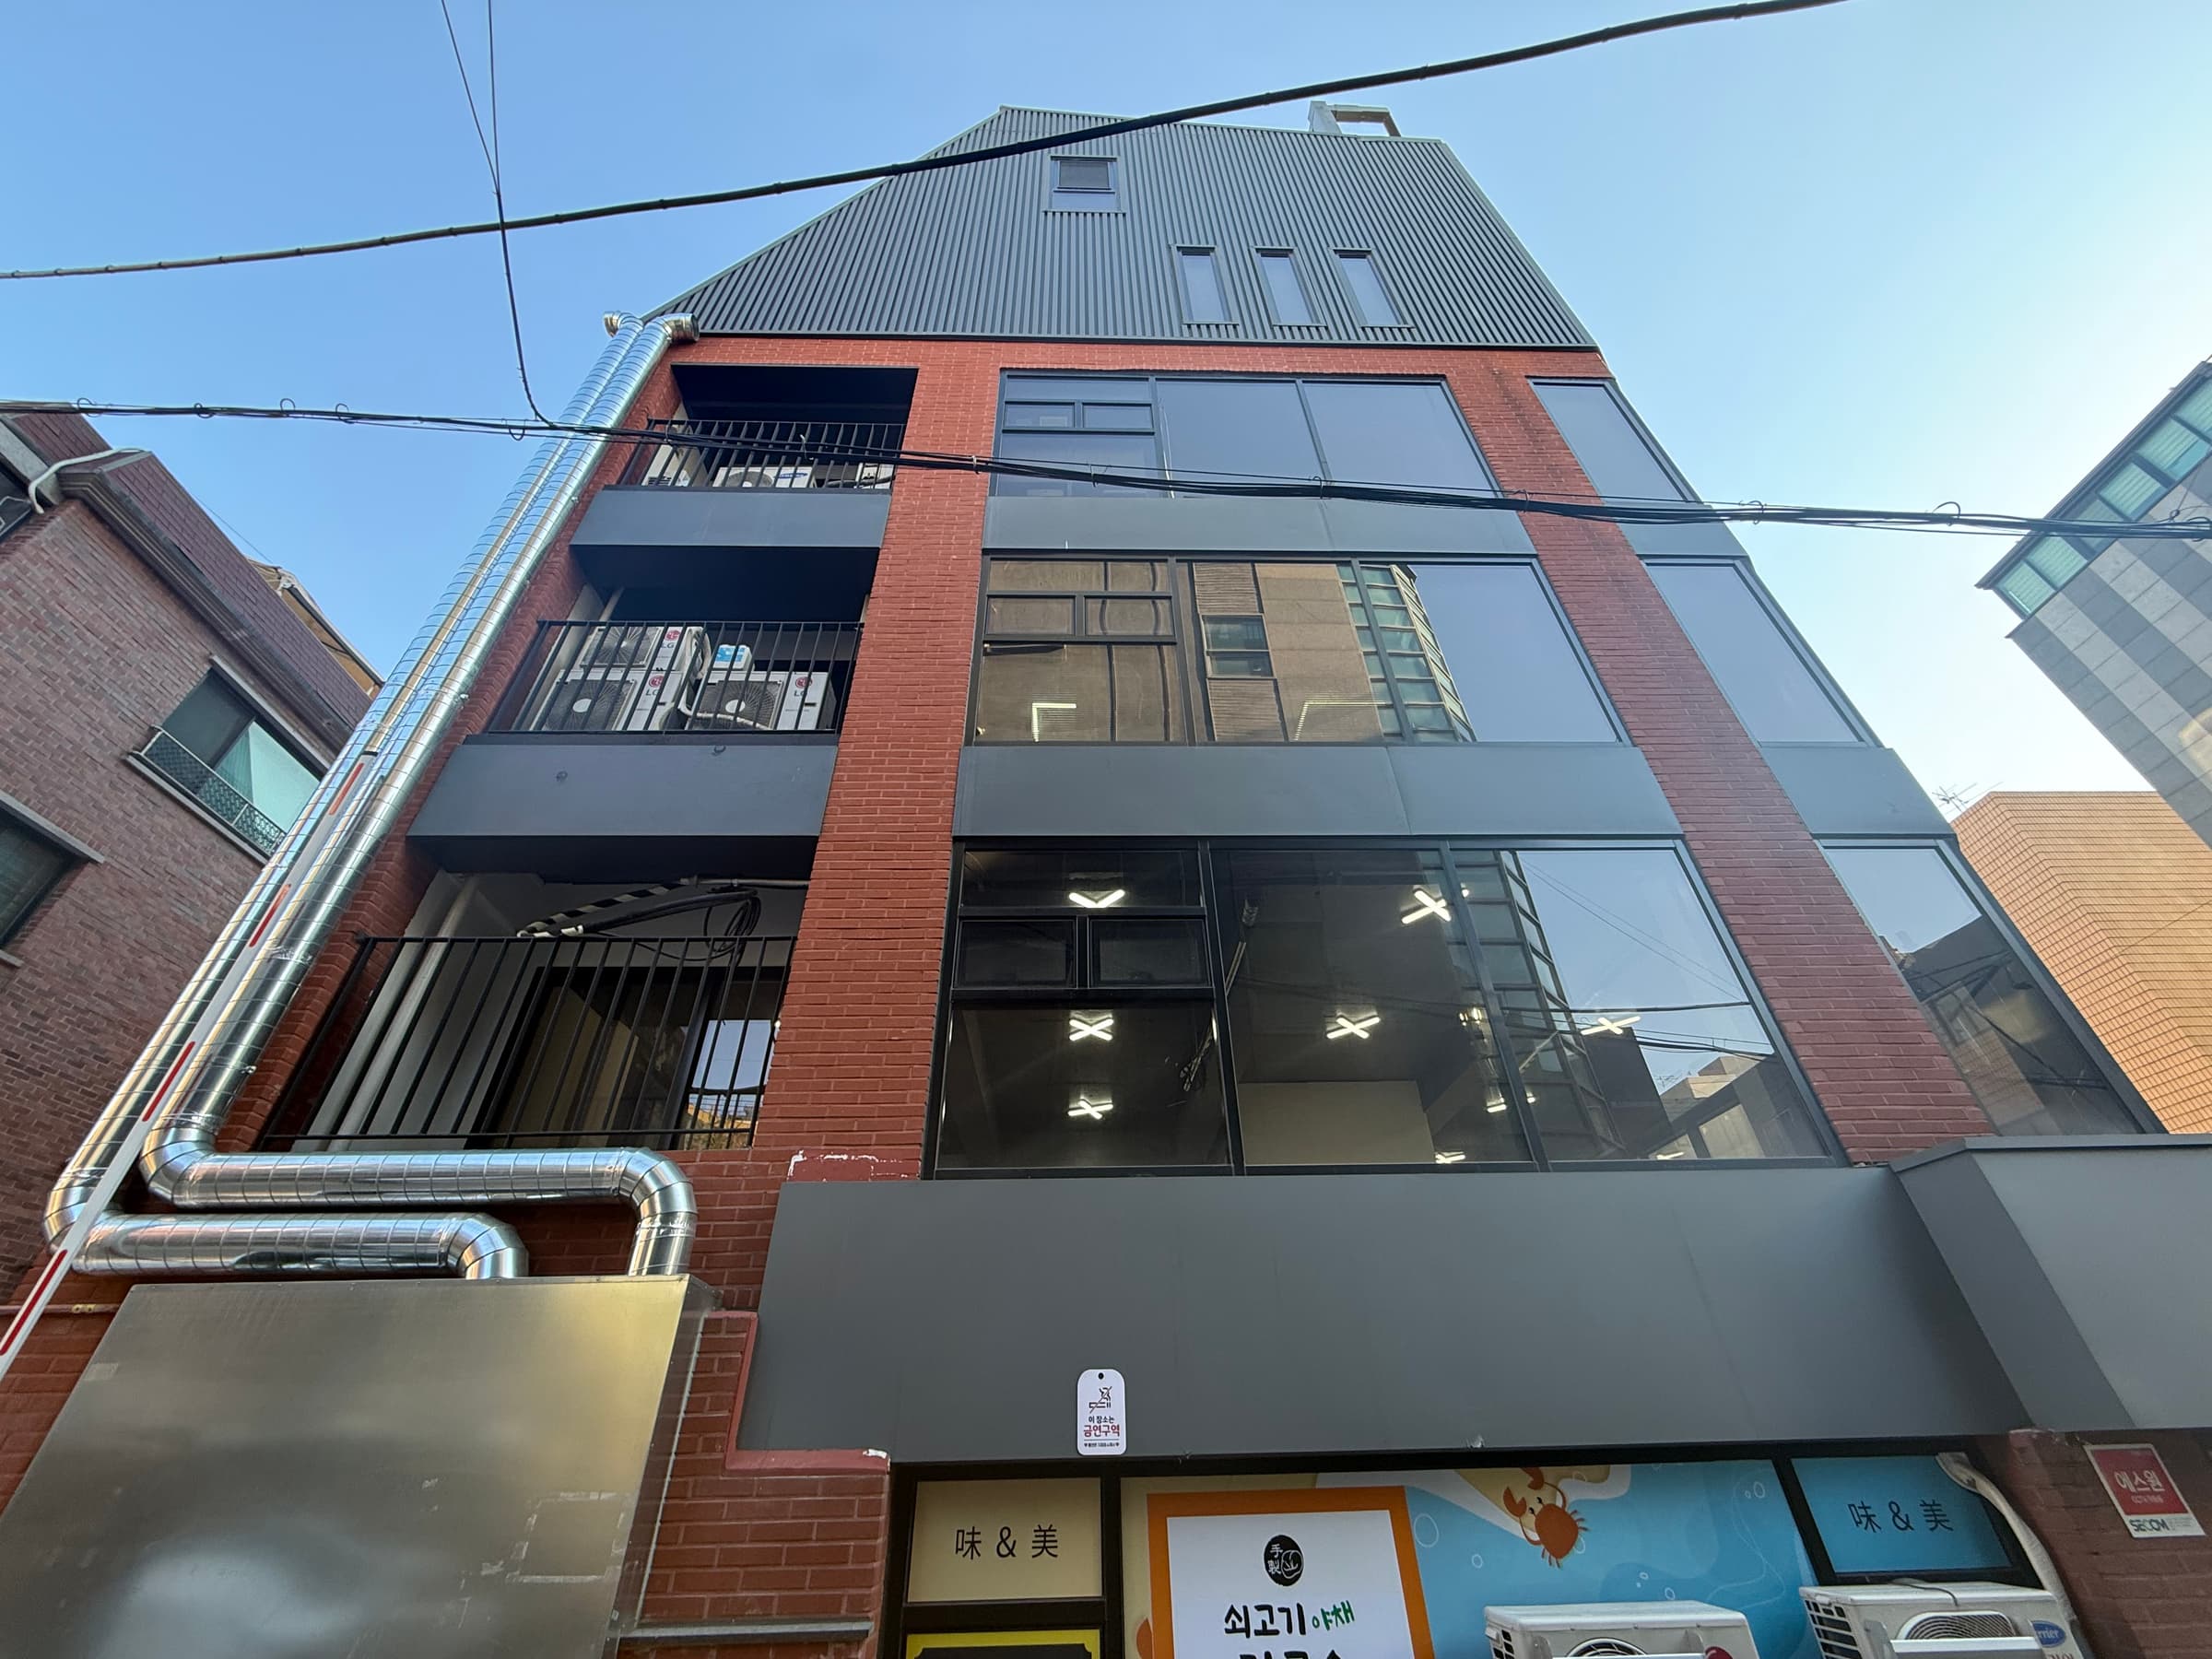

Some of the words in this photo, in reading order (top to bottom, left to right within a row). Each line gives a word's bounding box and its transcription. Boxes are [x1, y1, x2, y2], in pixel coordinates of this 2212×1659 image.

[1084, 1425, 1120, 1437] 금연구역
[1088, 1416, 1095, 1424] 이
[1097, 1416, 1114, 1424] 장소는
[2114, 1470, 2164, 1492] 에스원
[1847, 1500, 1882, 1533] 味
[1888, 1500, 1914, 1531] &
[1919, 1499, 1954, 1532] 美
[2129, 1519, 2170, 1531] SECOM
[955, 1526, 982, 1560] 味
[996, 1526, 1017, 1558] &
[1031, 1524, 1058, 1559] 美
[1224, 1602, 1307, 1639] 쇠고기
[1312, 1600, 1355, 1631] 야채
